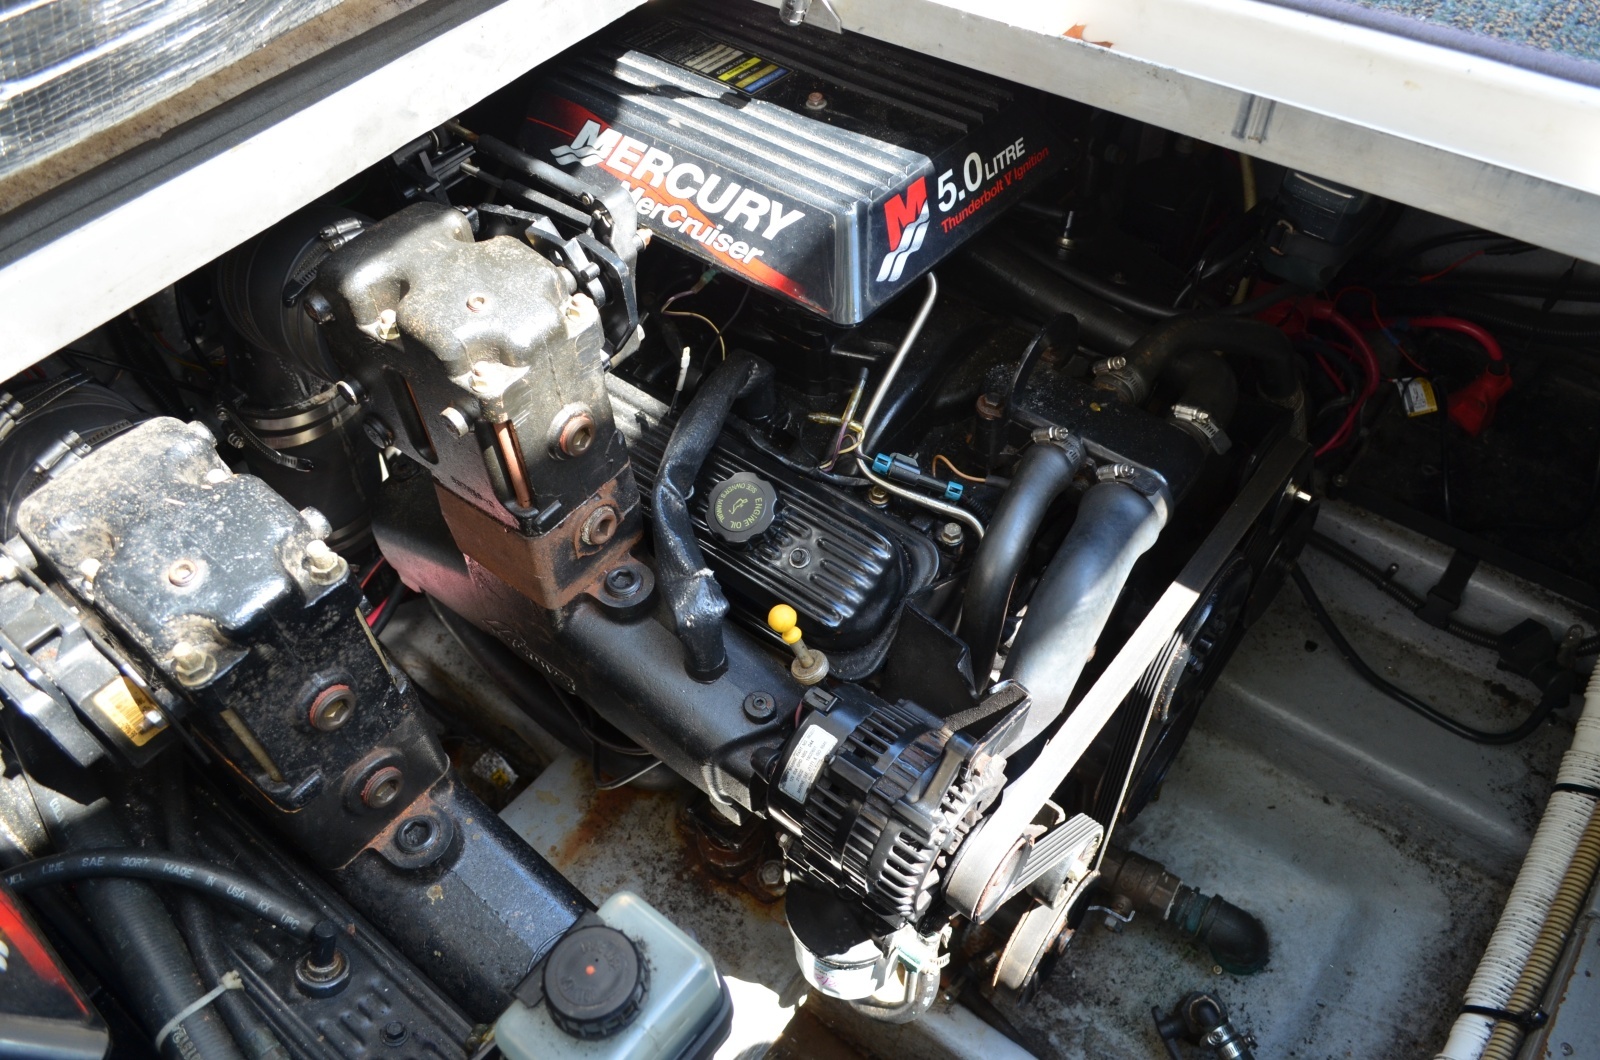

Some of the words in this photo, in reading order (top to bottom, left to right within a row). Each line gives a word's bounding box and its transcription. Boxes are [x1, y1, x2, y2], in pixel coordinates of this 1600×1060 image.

[550, 119, 806, 241] MERCURY
[938, 152, 983, 212] 5.0
[984, 137, 1026, 181] LITRE
[941, 179, 1004, 233] Thunderbolt
[1003, 171, 1013, 186] V
[1013, 147, 1050, 181] Ignition
[715, 499, 726, 523] MANUAL
[743, 497, 763, 527] ENGINE
[746, 483, 757, 494] SEE
[730, 520, 742, 529] OIL
[5, 873, 26, 886] UEL
[41, 861, 65, 875] LINE
[81, 856, 105, 867] SAE
[121, 857, 151, 868] 30R7
[162, 862, 195, 879] MADE
[205, 875, 217, 887] IN
[226, 884, 247, 900] USA
[280, 913, 300, 930] UPC
